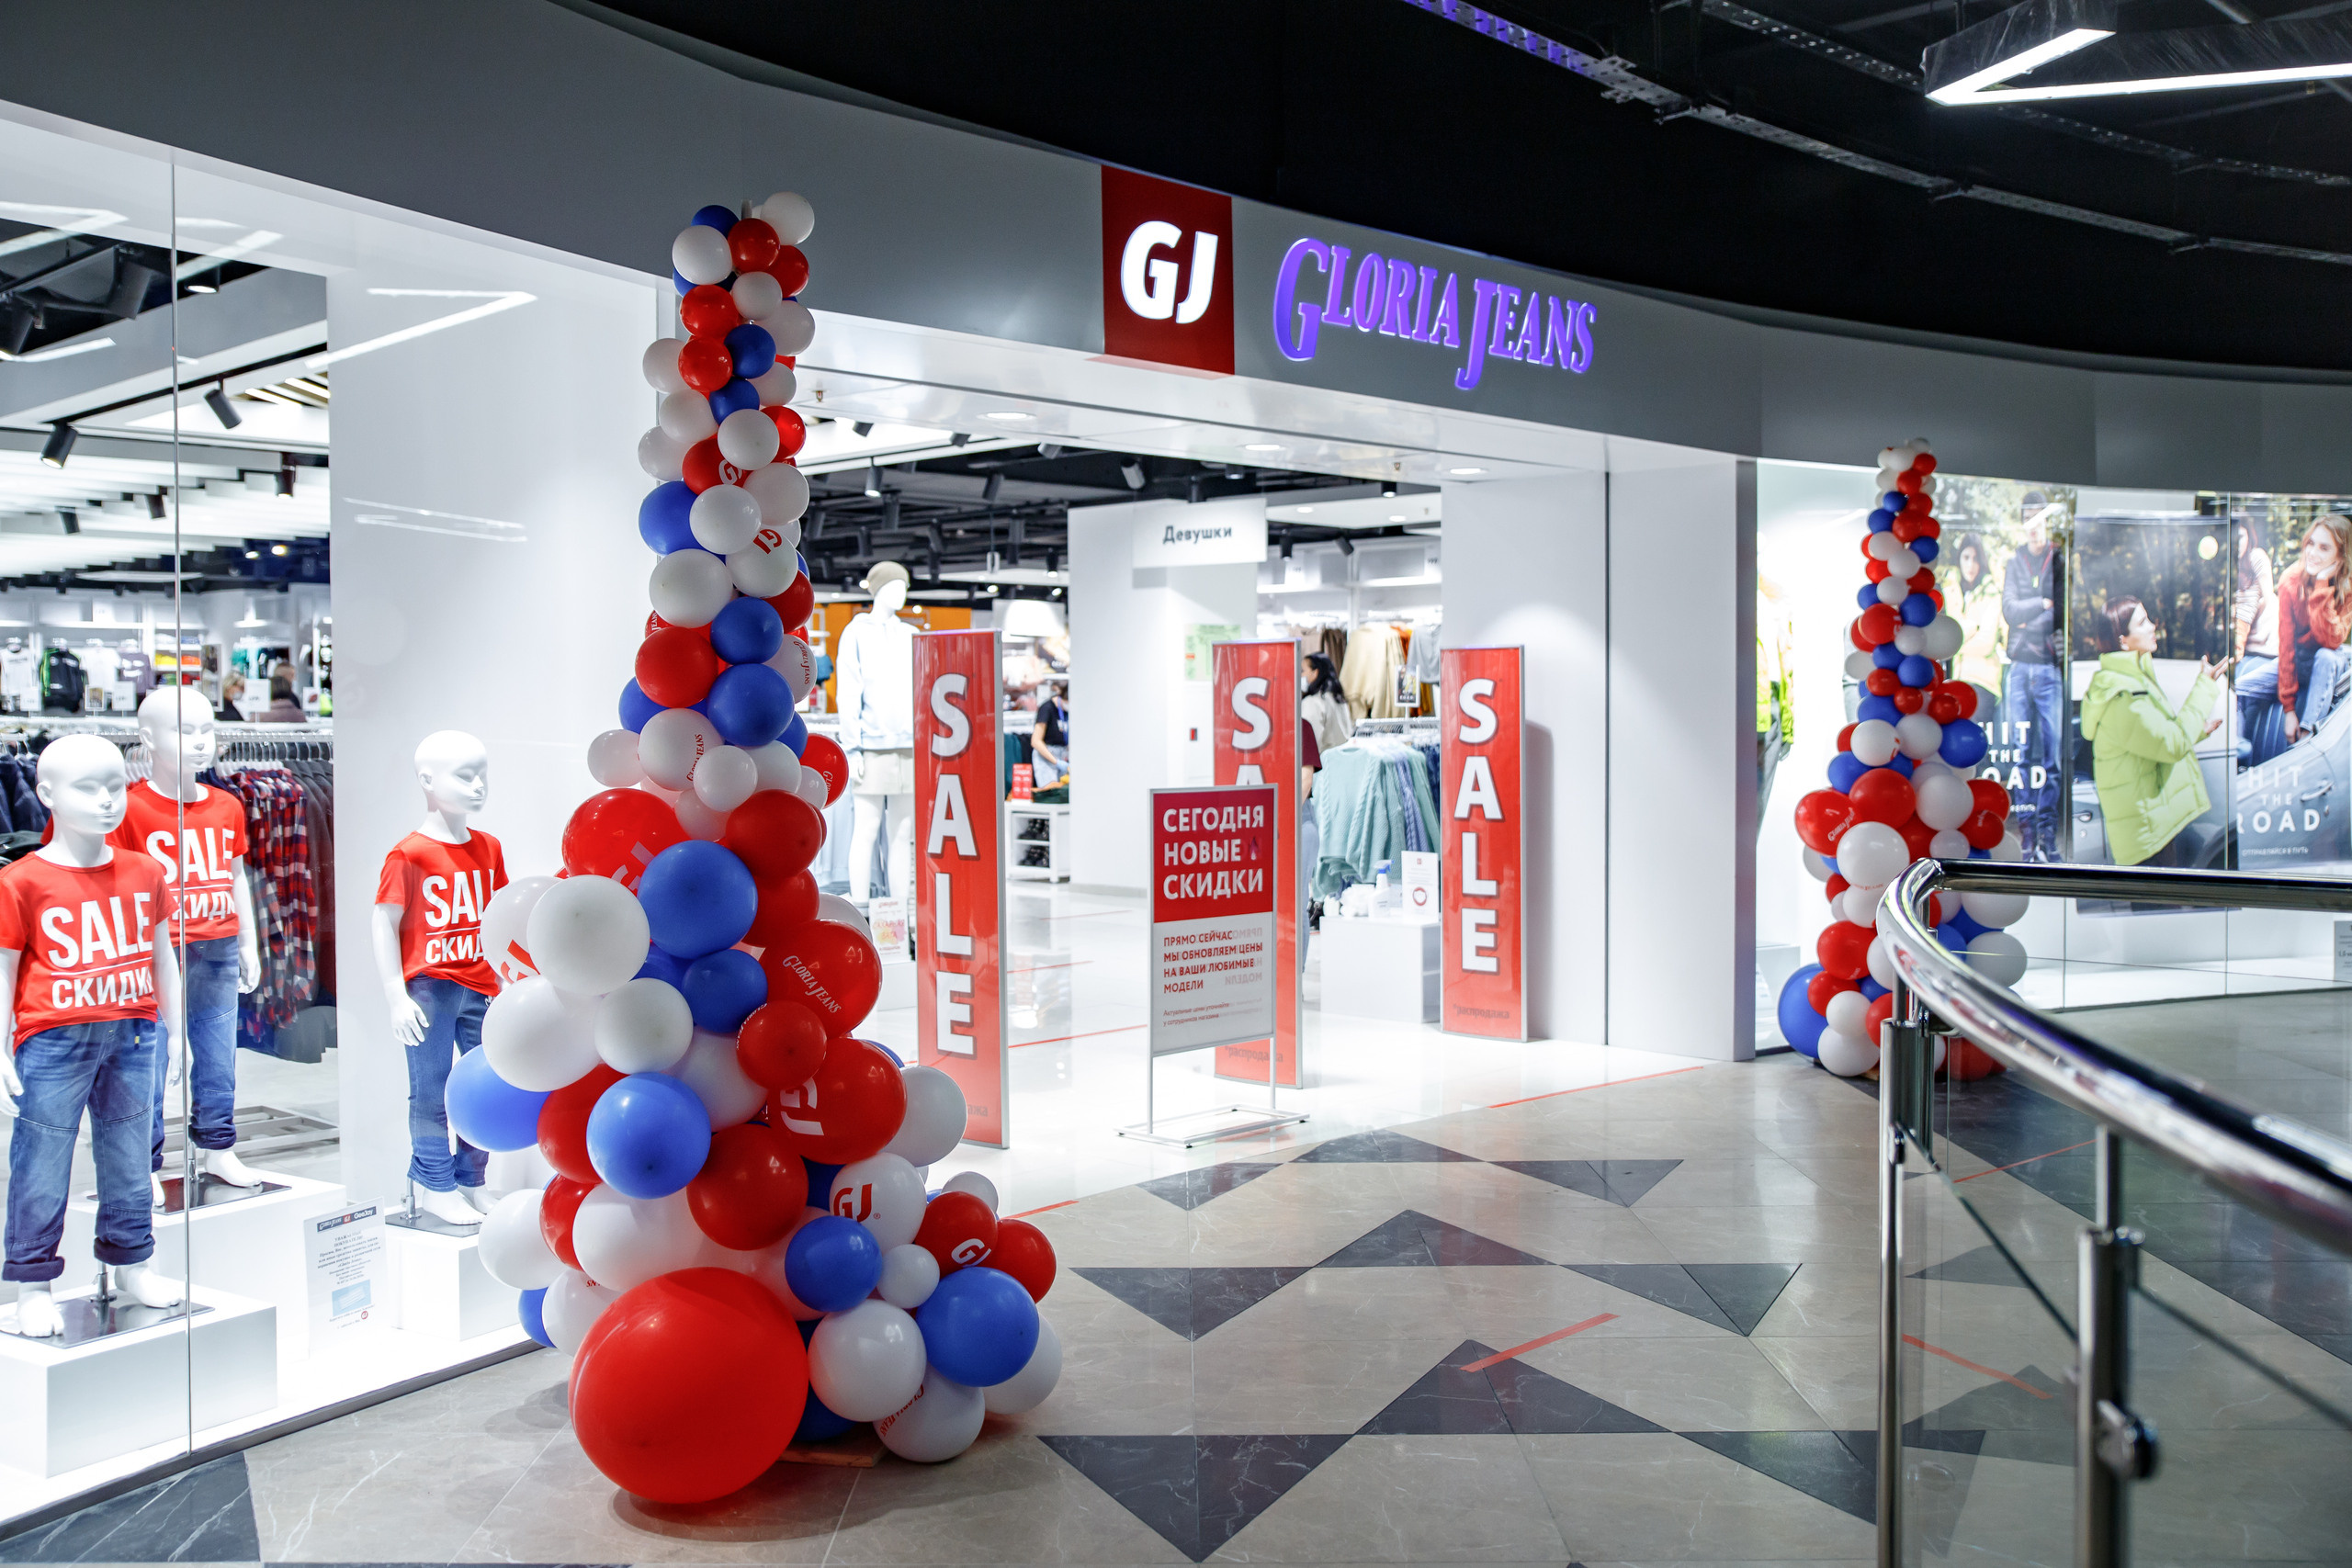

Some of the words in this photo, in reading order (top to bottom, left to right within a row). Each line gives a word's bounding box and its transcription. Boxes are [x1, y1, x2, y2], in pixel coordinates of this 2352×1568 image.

[1121, 220, 1219, 324] GJ
[1272, 237, 1461, 362] GLORIA
[1454, 277, 1598, 390] JEANS
[1162, 524, 1233, 545] Девушки
[1988, 749, 2022, 763] THE
[1981, 765, 2048, 790] OAD
[2248, 764, 2303, 789] HIT
[2260, 793, 2293, 807] THE
[1162, 806, 1264, 833] СЕГОДНЯ
[1454, 678, 1504, 975] SALE
[1163, 838, 1241, 866] НОВЫЕ
[927, 672, 979, 1059] SALE
[1162, 868, 1263, 900] СКИДКИ
[40, 892, 153, 968] SALE
[1163, 934, 1196, 947] ПРЯМО
[1198, 931, 1233, 943] СЕЙЧАС
[1163, 952, 1180, 963] МЫ
[1182, 945, 1237, 960] ОБНОВЛЯЕМ
[1238, 942, 1263, 955] ЦЕНЫ
[1163, 967, 1177, 978] НА
[1180, 964, 1206, 976] ВАШИ
[1208, 958, 1254, 973] ЛЮБИМЫЕ
[782, 955, 817, 989] GLORIA
[805, 986, 842, 1013] JEANS
[1163, 979, 1204, 994] МОДЕЛИ
